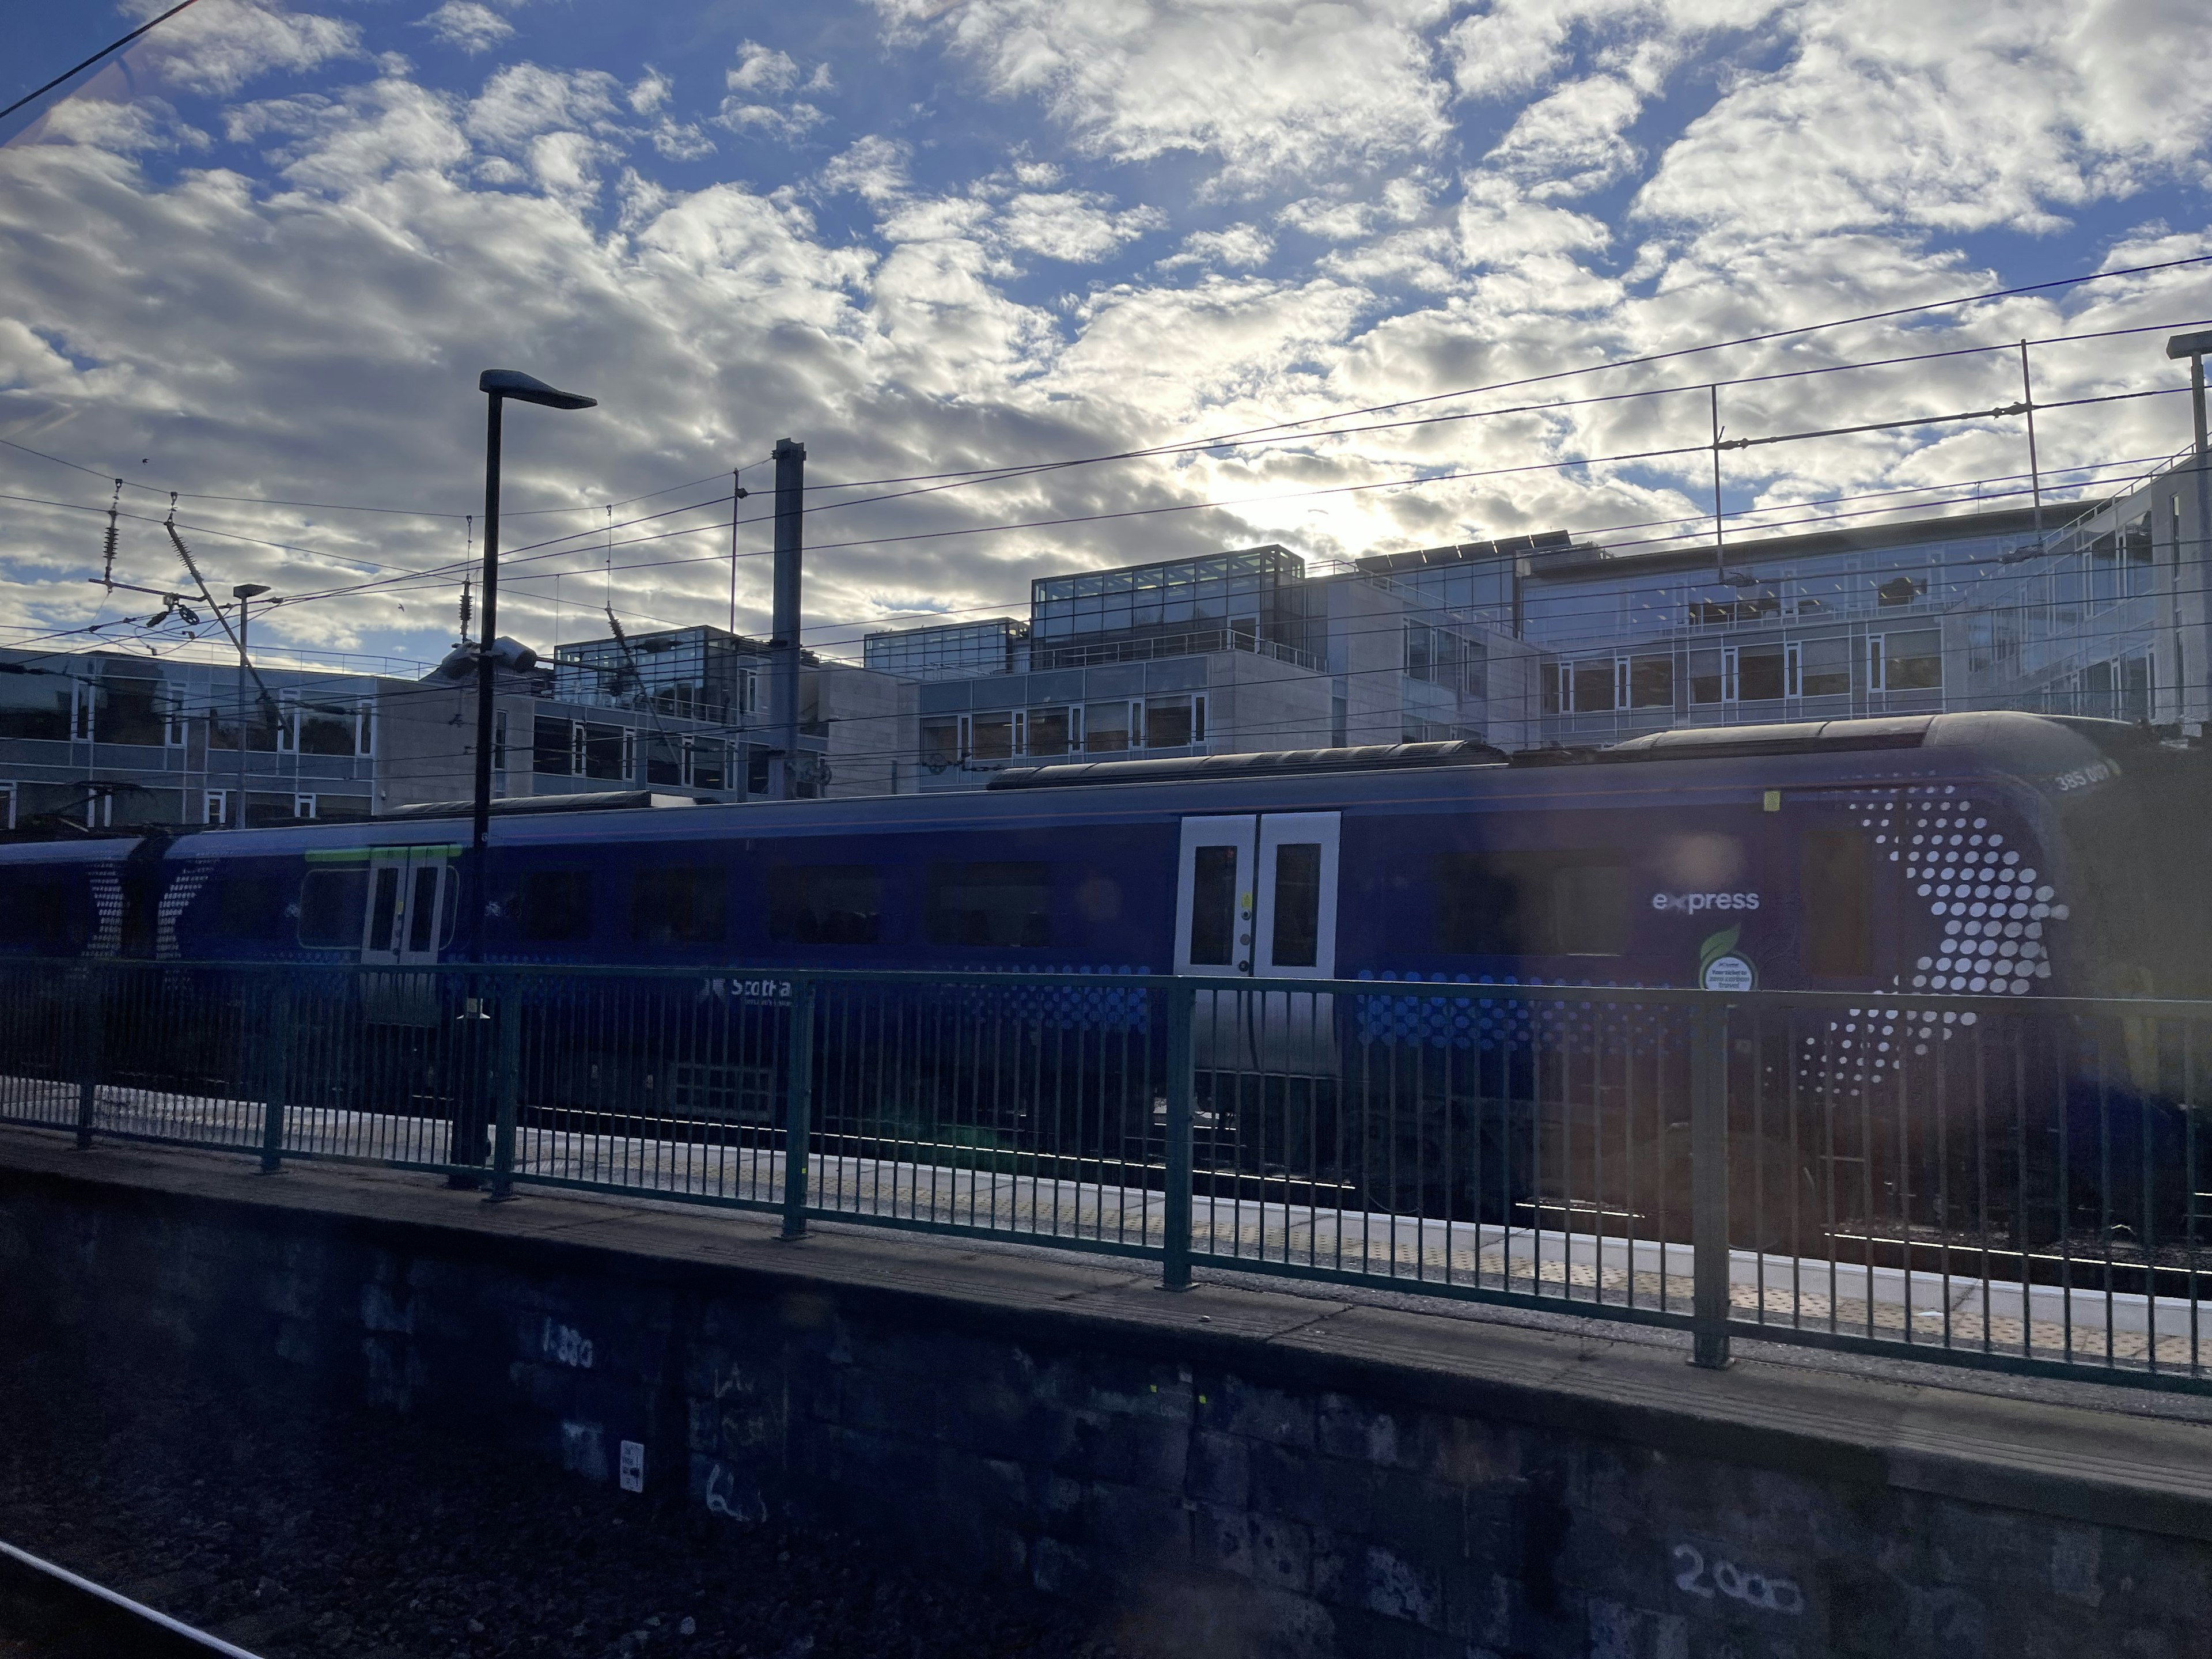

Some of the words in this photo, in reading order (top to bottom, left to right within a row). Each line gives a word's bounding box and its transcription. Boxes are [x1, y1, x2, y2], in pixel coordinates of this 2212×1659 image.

[2055, 771, 2086, 791] 385
[1652, 892, 1760, 915] express
[1673, 1544, 1804, 1615] 2000
